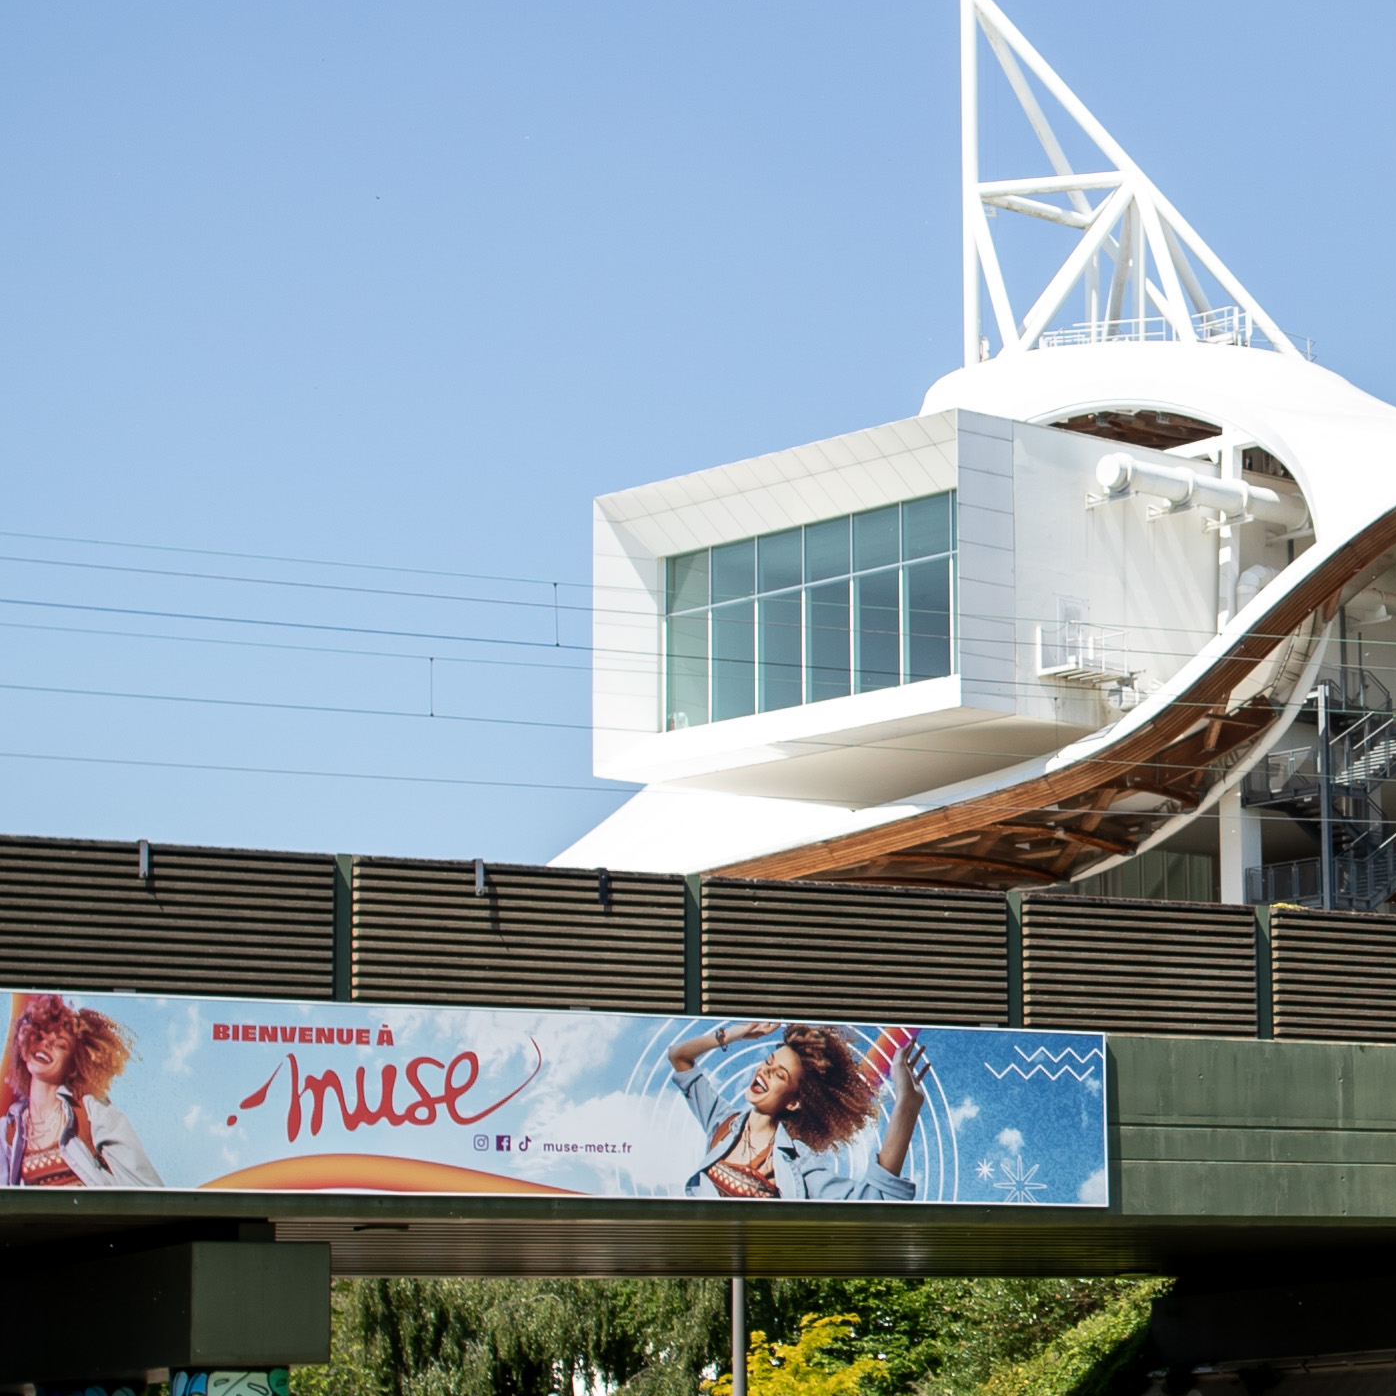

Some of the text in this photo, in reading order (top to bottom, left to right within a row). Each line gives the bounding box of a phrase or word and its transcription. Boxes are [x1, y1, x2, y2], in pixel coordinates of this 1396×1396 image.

[212, 1022, 395, 1047] BIENVENUE À
[543, 1140, 632, 1154] muse-metz.fr
